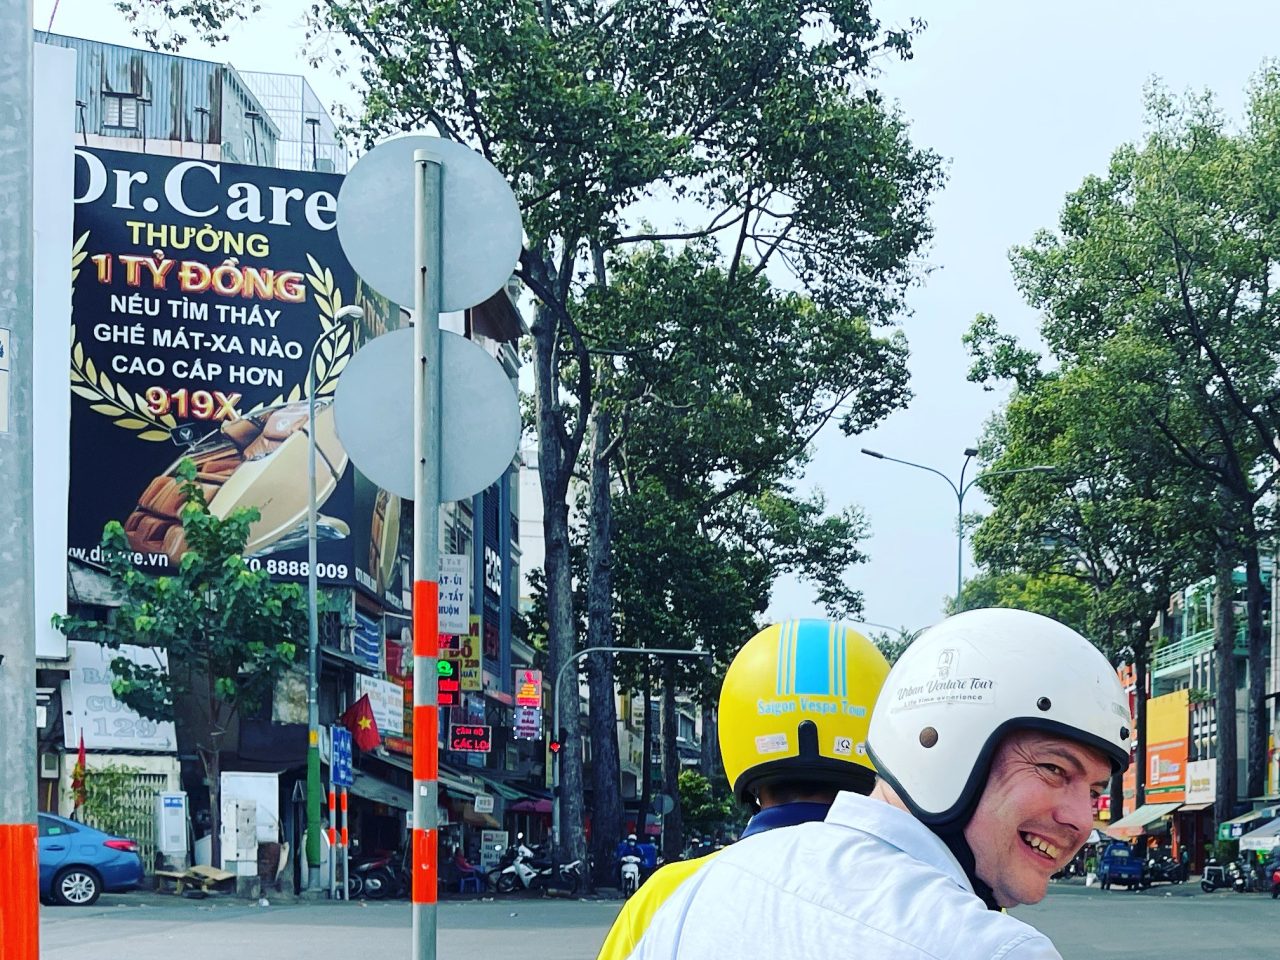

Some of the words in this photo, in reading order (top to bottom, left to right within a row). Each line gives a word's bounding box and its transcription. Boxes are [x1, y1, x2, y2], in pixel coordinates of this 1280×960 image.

[126, 221, 269, 257] THƯỞNG
[91, 254, 113, 284] 1
[118, 249, 175, 290] TỶ
[167, 297, 208, 321] TÌM
[152, 327, 244, 354] MÁT-XA
[250, 335, 303, 359] NÀO
[111, 355, 165, 376] CAO
[229, 365, 283, 387] HƠN
[146, 387, 242, 421] 919X
[315, 563, 348, 579] 009
[969, 677, 993, 690] Tour
[800, 696, 837, 714] Vespa
[93, 717, 156, 738] 129
